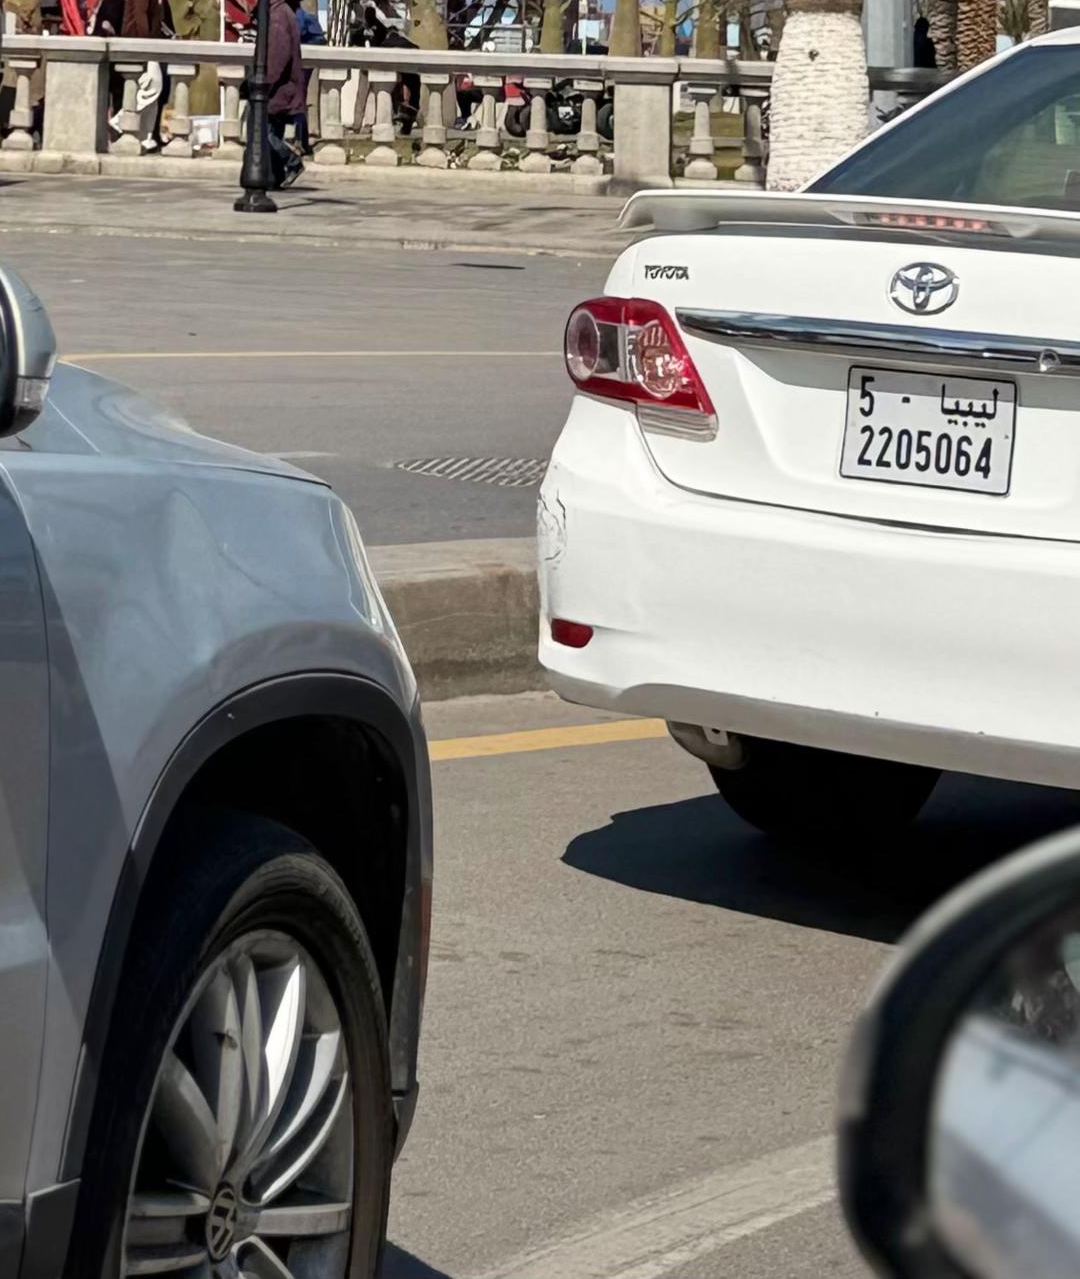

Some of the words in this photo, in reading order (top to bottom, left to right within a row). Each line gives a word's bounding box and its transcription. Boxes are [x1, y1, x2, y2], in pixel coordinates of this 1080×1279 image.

[859, 375, 875, 417] 5
[941, 383, 999, 428] ليبيا
[857, 425, 993, 479] 2205064
